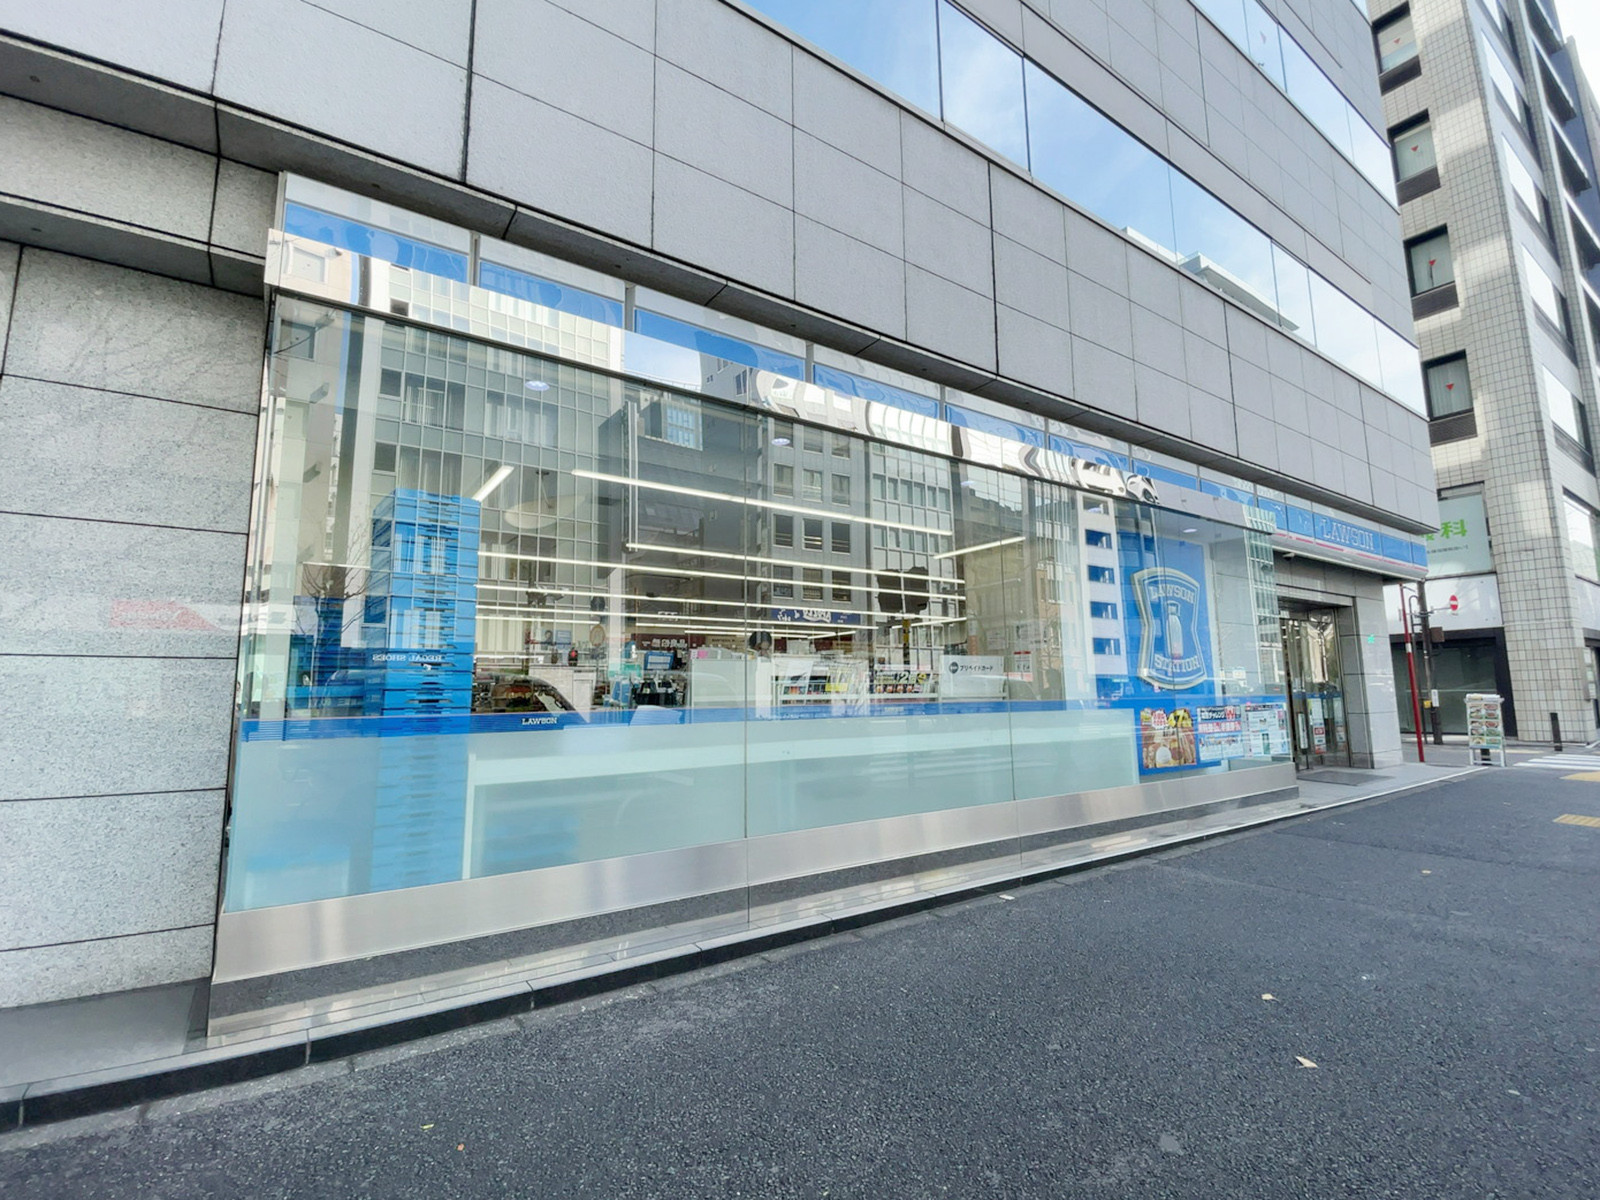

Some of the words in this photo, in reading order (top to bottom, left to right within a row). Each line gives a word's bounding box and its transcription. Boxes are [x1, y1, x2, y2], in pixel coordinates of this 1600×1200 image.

[1321, 518, 1374, 551] LAWSON
[1148, 583, 1195, 604] LAWSON
[1153, 653, 1200, 676] STATION
[521, 716, 558, 726] LAWSON
